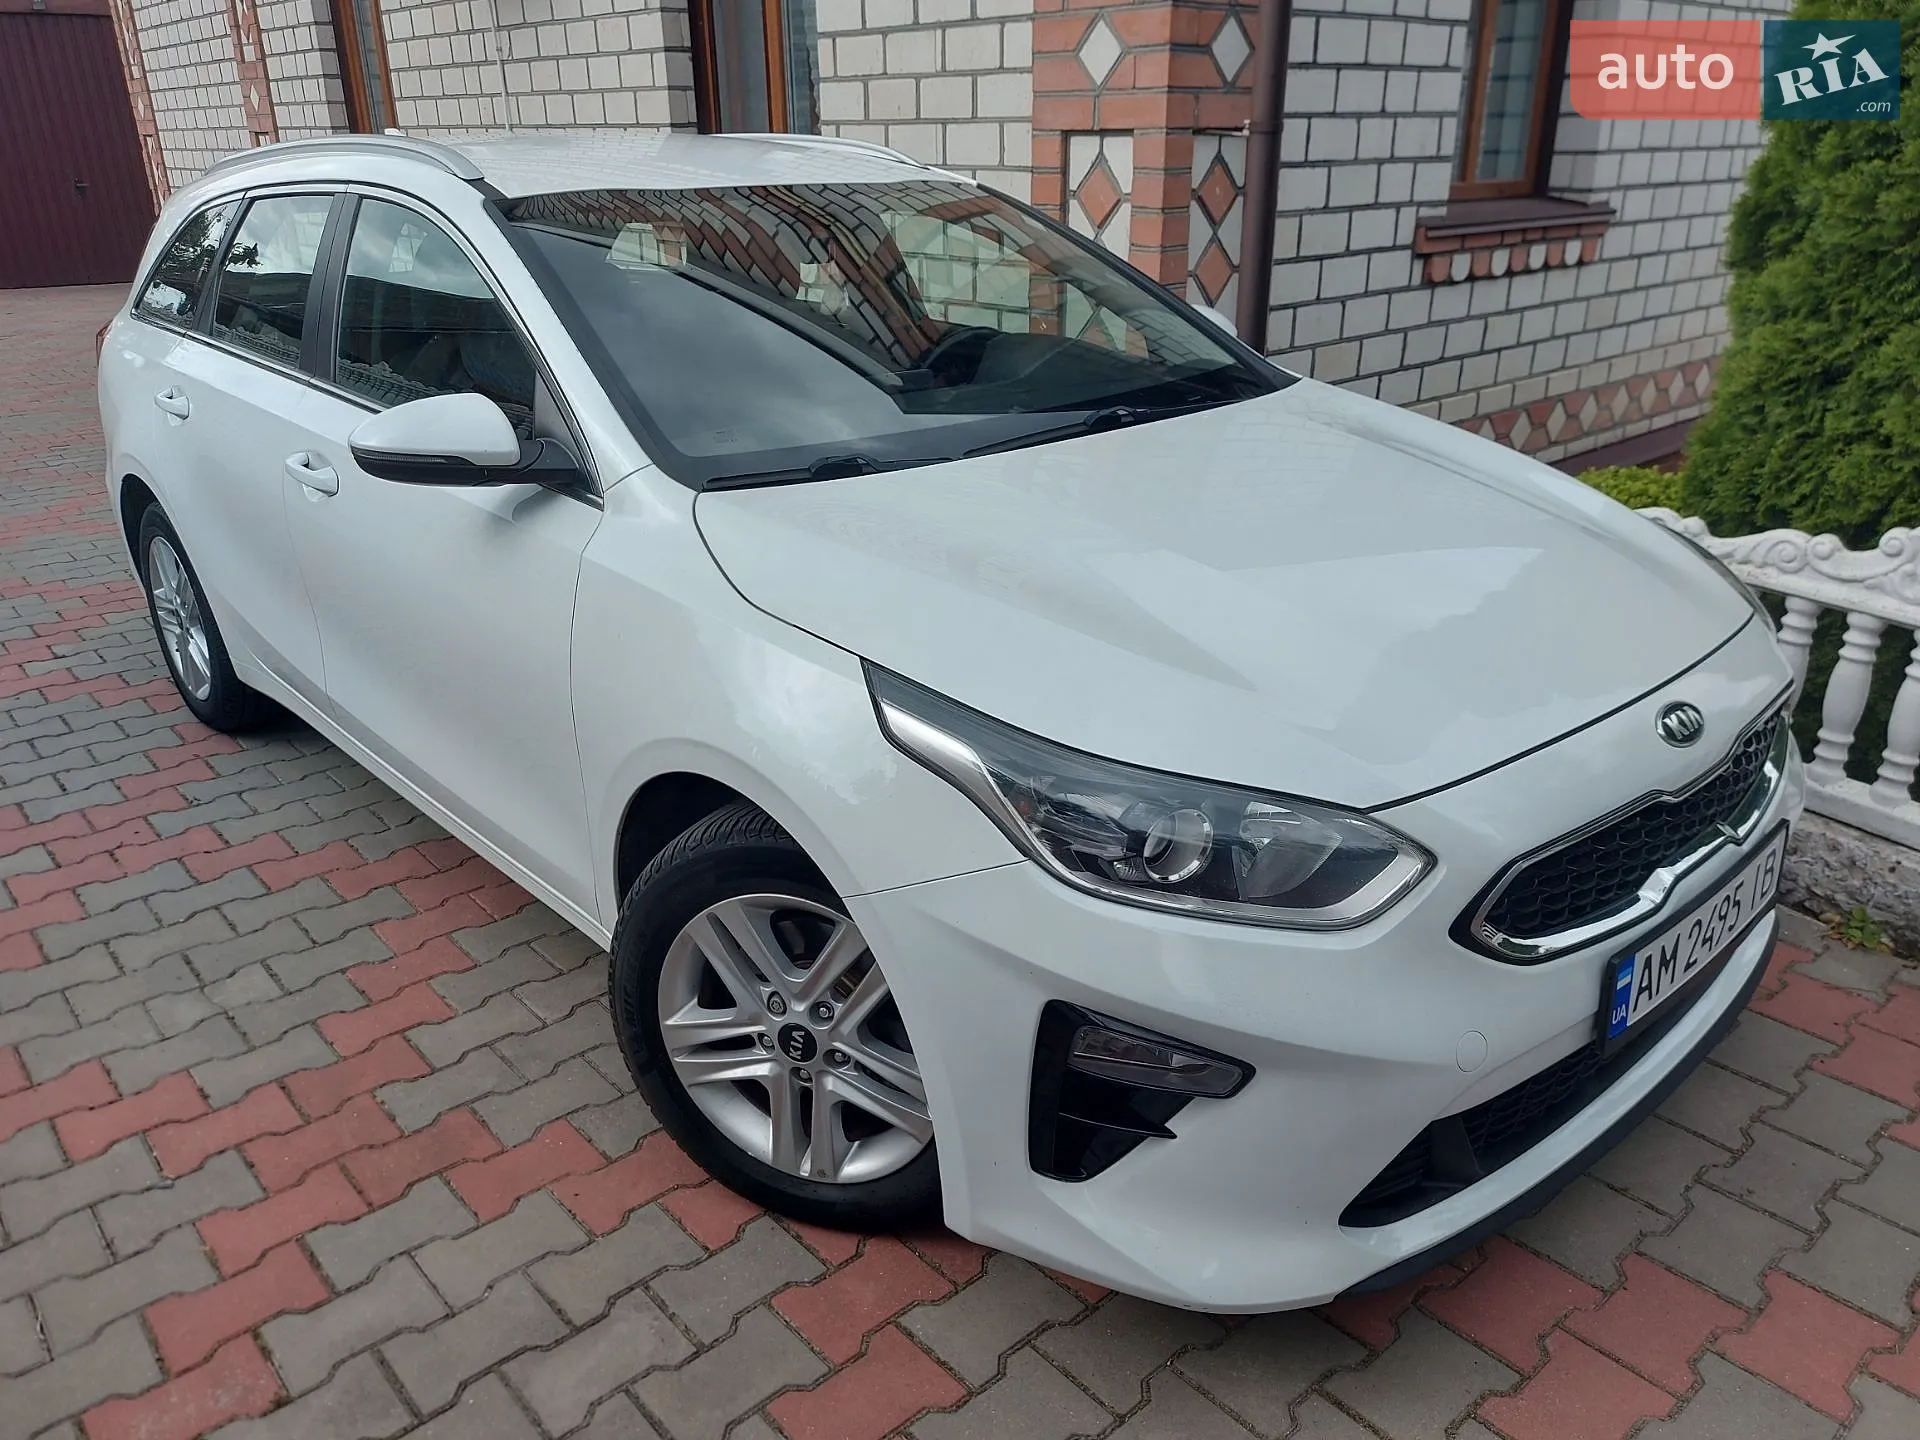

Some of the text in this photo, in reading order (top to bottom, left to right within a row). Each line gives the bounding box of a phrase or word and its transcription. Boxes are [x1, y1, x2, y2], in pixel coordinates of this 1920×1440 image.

[1662, 705, 1704, 740] KIA
[1632, 848, 1777, 1013] AM 2495 IB
[1612, 1003, 1627, 1025] UA
[789, 1030, 805, 1060] KIA
